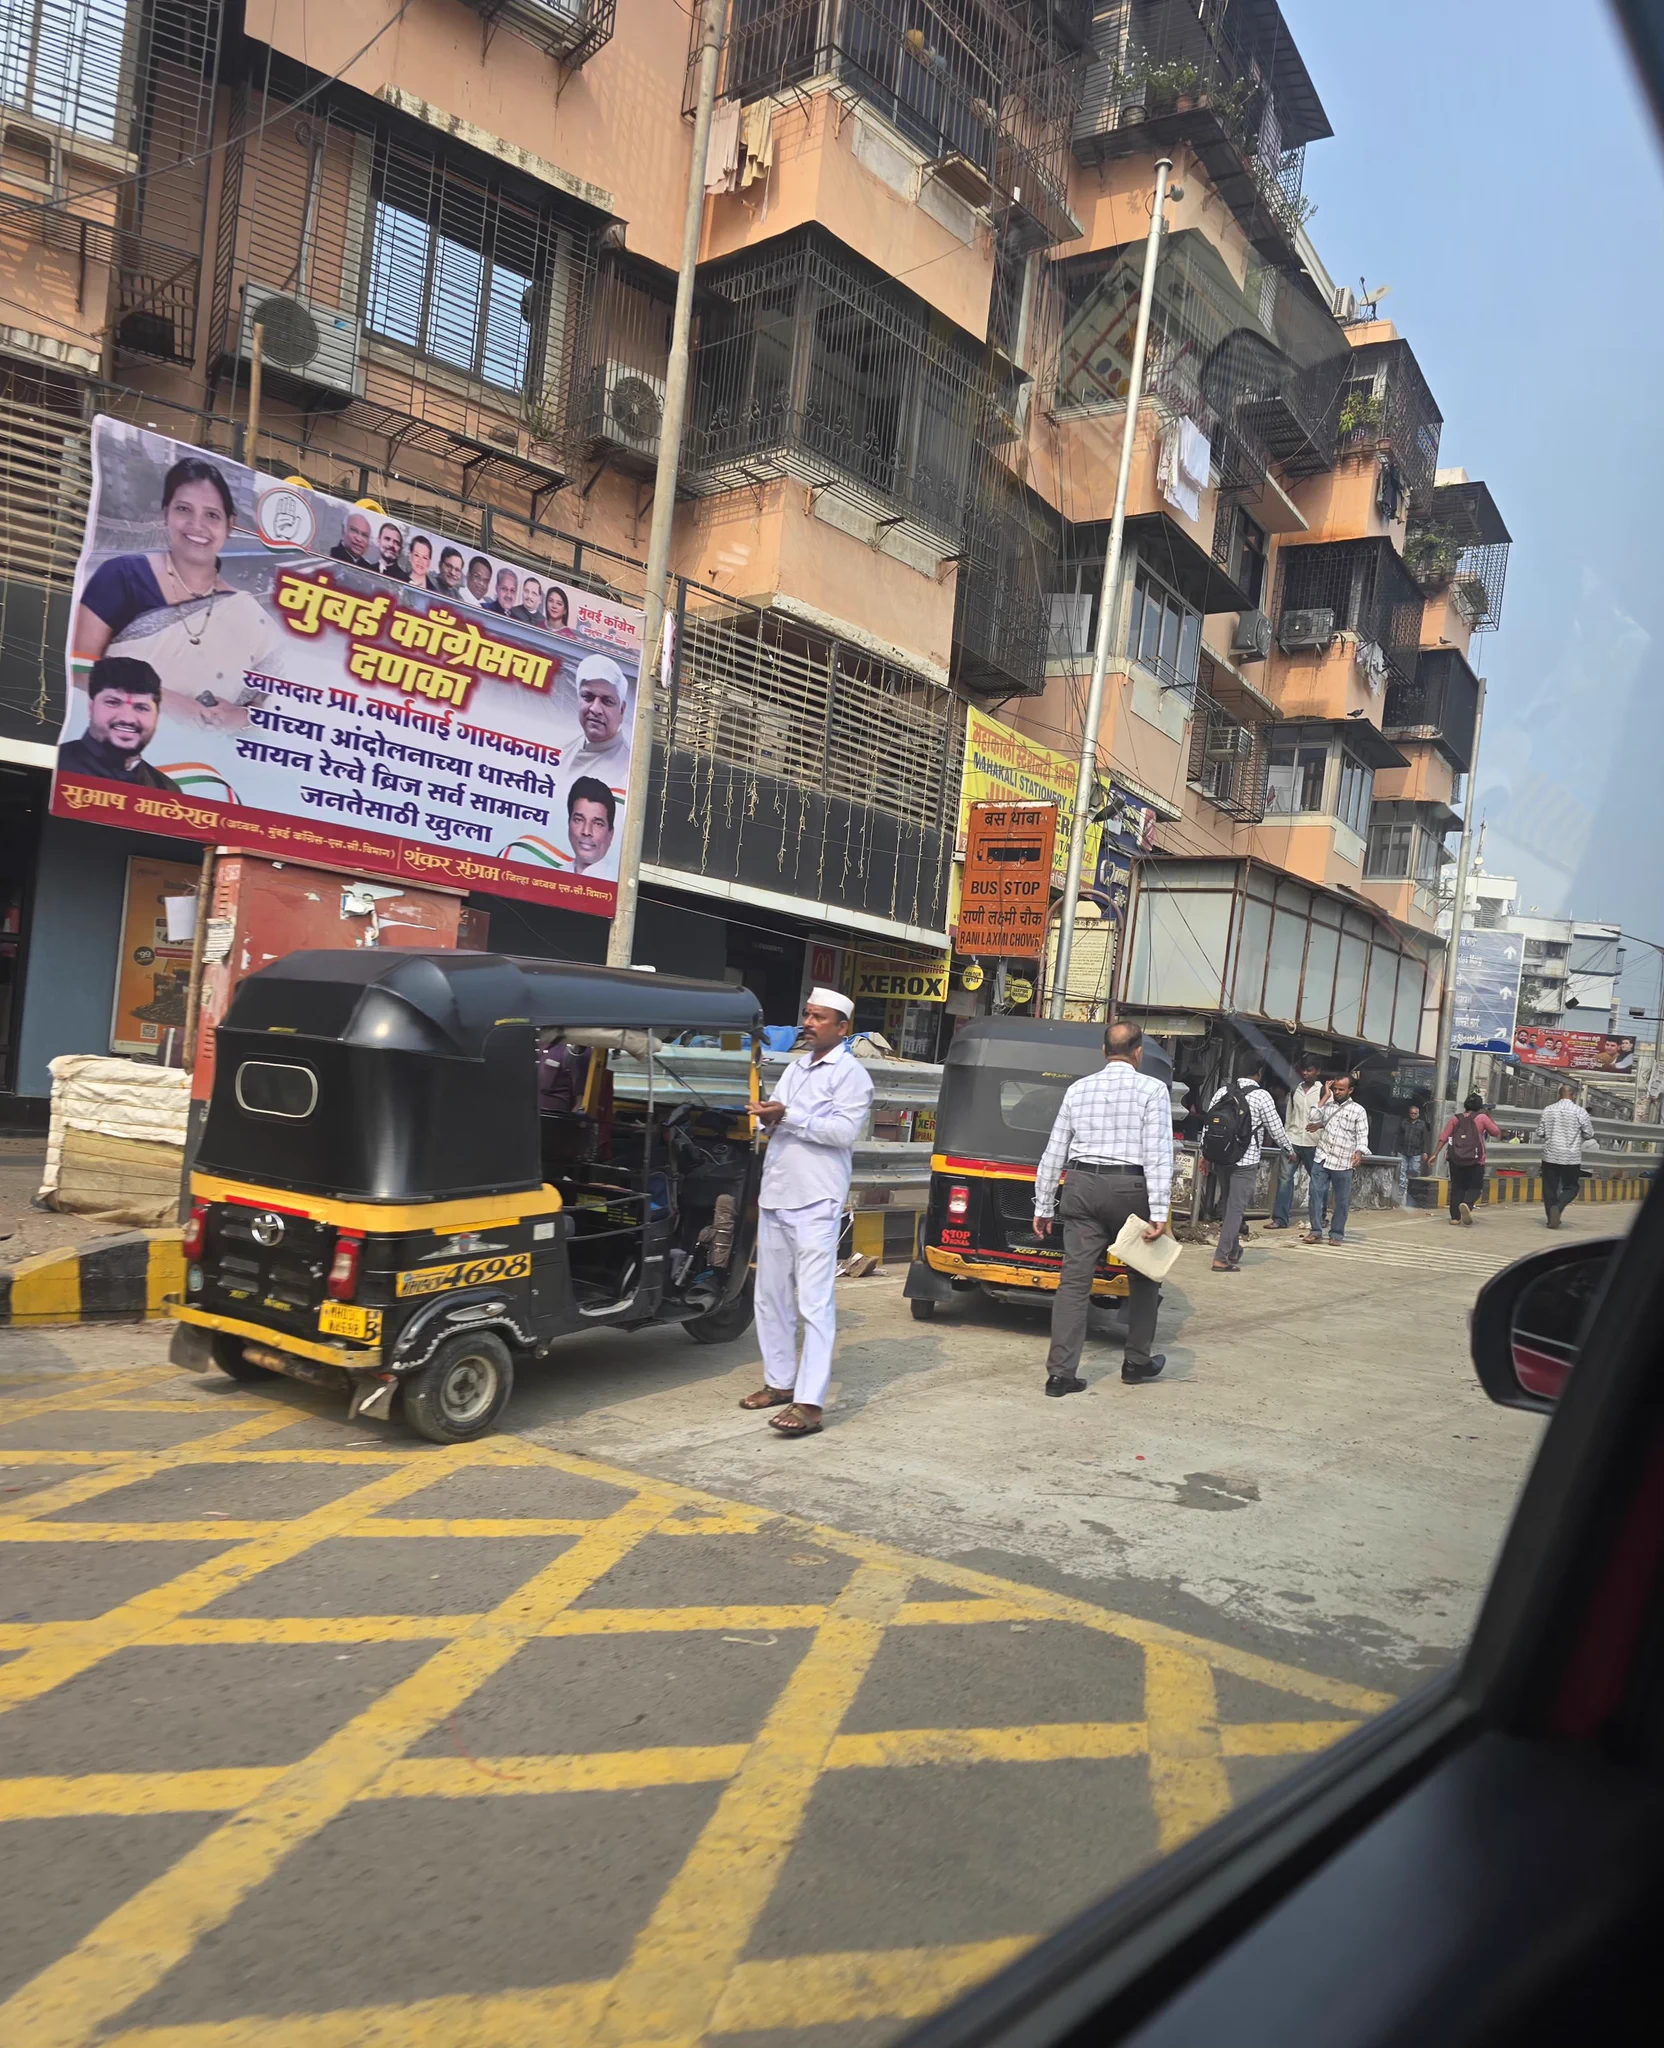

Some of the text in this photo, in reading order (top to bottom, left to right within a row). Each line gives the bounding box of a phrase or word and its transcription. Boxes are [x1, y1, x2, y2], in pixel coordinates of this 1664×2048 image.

[278, 575, 390, 634] मुंबई
[578, 604, 603, 624] मुंबई
[349, 643, 472, 707] दणका
[242, 669, 323, 706] खासदार
[456, 721, 563, 767] गायकवाड
[248, 704, 555, 799] यांच्या आंदोलनाच्या धास्तीने
[235, 736, 550, 827] सायन रेल्वे ब्रिज सर्व सामान्य
[973, 752, 1018, 788] MAHAKALI
[300, 784, 494, 845] जनतेसाठी खुल्ला
[984, 812, 1006, 826] बस
[1010, 807, 1042, 826] थांबा
[403, 845, 452, 873] शंकर
[455, 856, 501, 881] संगम
[970, 881, 1041, 896] BUS STOP
[962, 905, 1043, 926] राणी लक्ष्मी चौक
[960, 931, 1041, 948] RANI LAXMI CHOWK
[858, 974, 943, 997] XEROX
[941, 1228, 971, 1245] STOP
[441, 1254, 529, 1287] 4698
